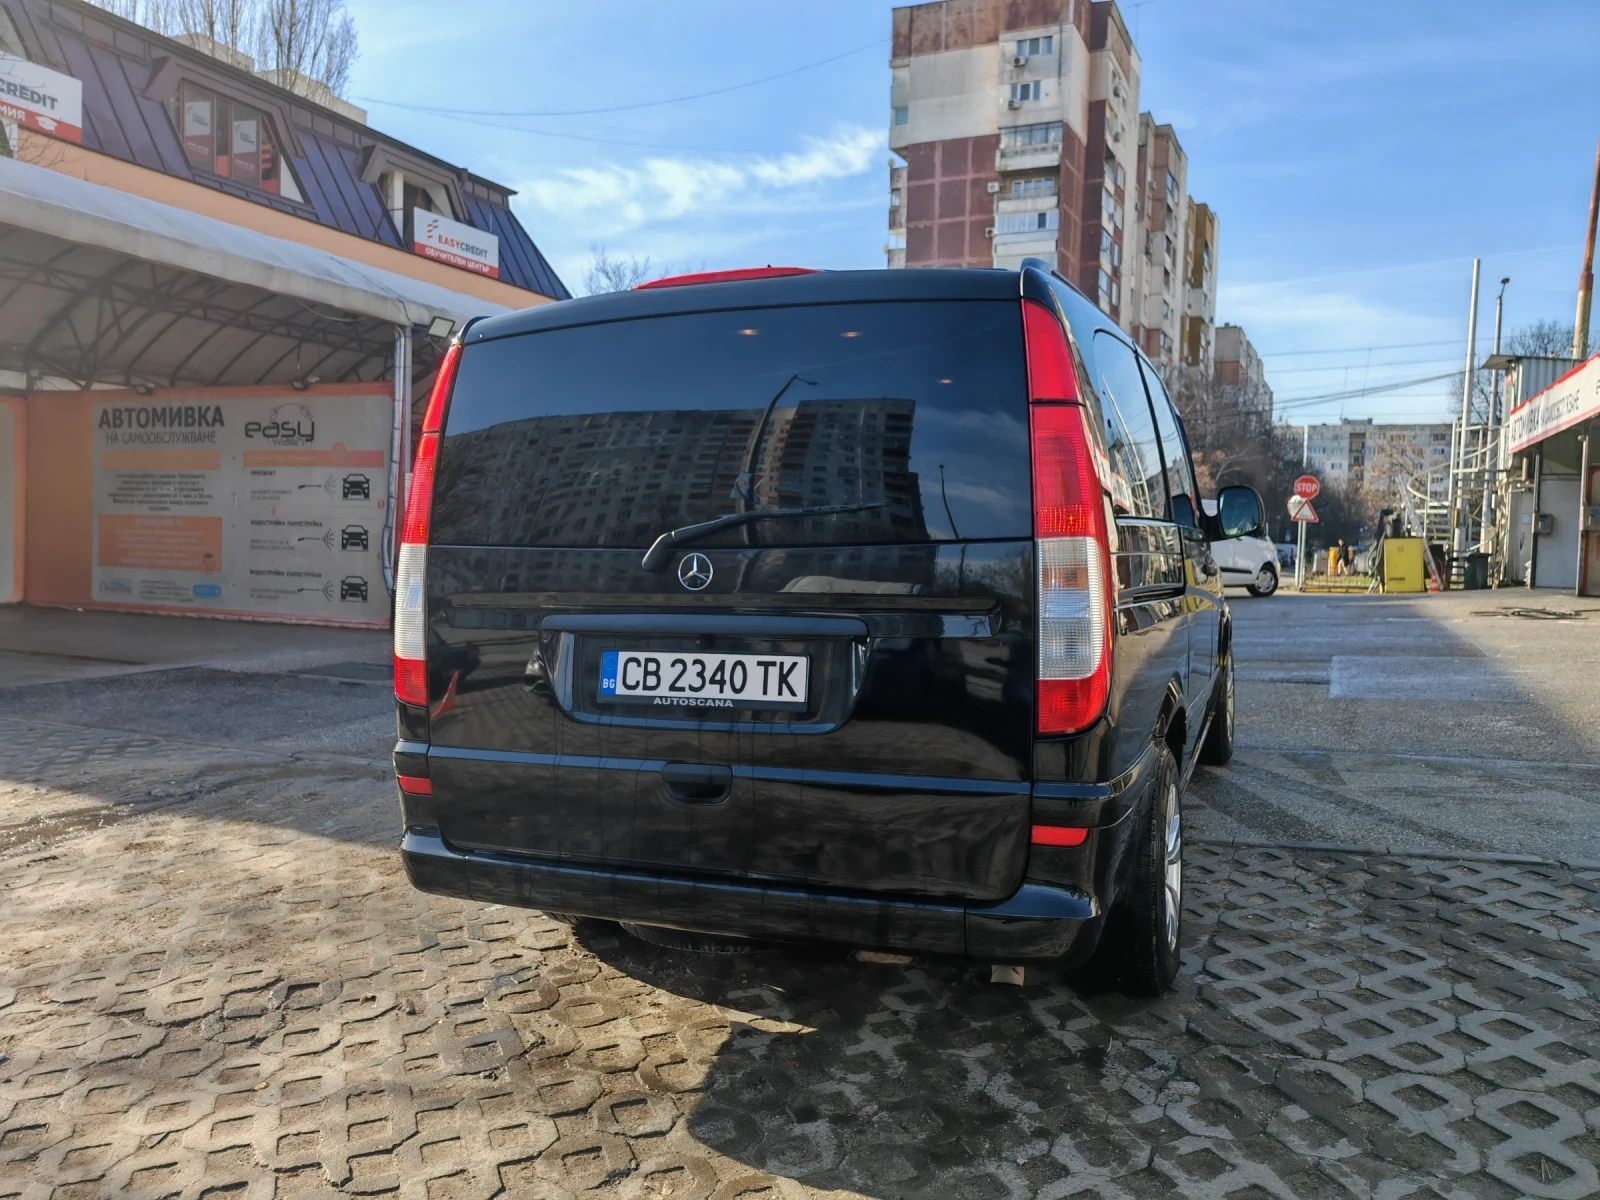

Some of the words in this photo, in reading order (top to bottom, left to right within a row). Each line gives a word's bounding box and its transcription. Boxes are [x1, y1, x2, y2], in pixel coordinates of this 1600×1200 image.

[438, 234, 488, 258] EASYCREDIT
[99, 405, 225, 429] АВТОМИВКА
[106, 433, 119, 444] НА
[121, 431, 217, 444] САМООБСЛУЖВАНЕ
[244, 420, 315, 442] easy
[1296, 482, 1318, 493] STOP
[602, 678, 616, 689] BG
[622, 656, 662, 692] CB
[668, 658, 749, 694] 2340
[756, 660, 799, 698] TK
[653, 696, 735, 708] AUTOSCANA
